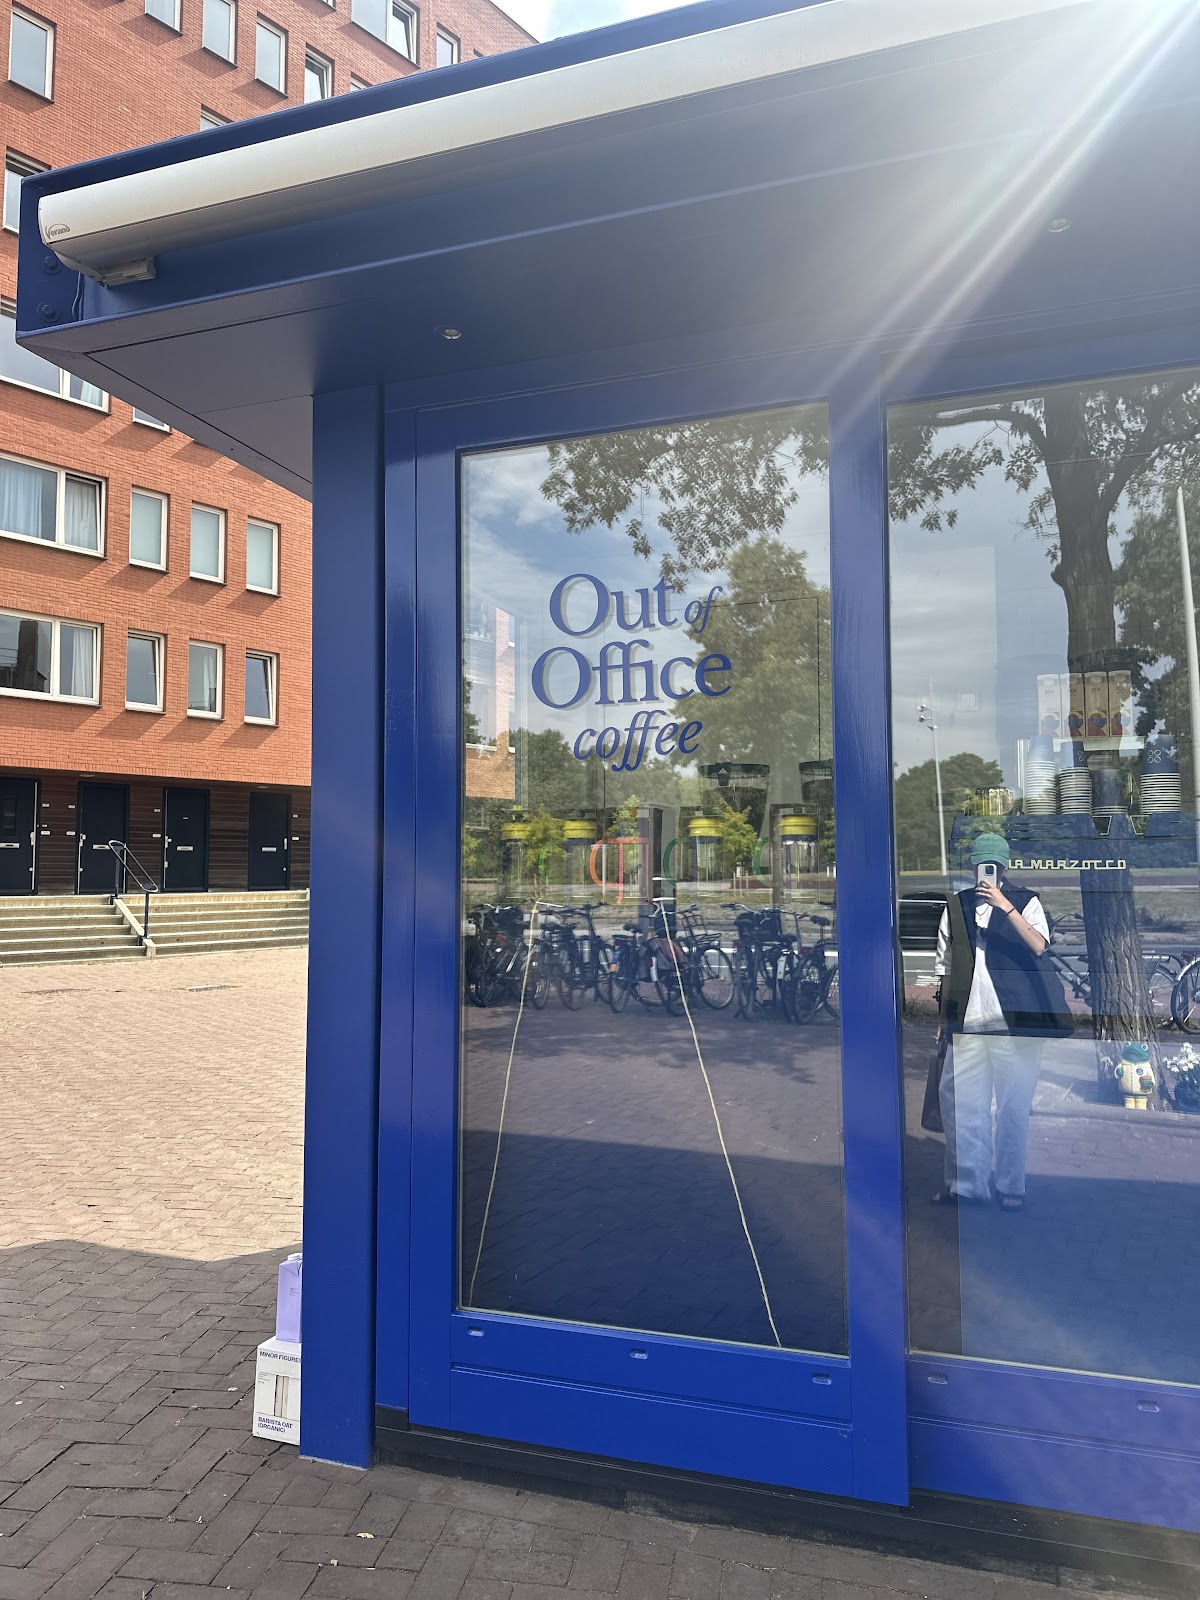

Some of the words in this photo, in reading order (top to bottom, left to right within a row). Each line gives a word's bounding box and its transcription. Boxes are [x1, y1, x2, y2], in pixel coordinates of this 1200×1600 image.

[45, 223, 71, 240] Verano
[550, 573, 678, 637] Out
[684, 585, 723, 634] of
[531, 639, 732, 709] Office
[573, 709, 703, 772] coffee
[1008, 859, 1023, 869] LA
[1031, 859, 1127, 870] MARZOCCO
[260, 1351, 278, 1359] MINOR
[258, 1416, 281, 1426] BARISTA
[281, 1420, 293, 1429] OAT
